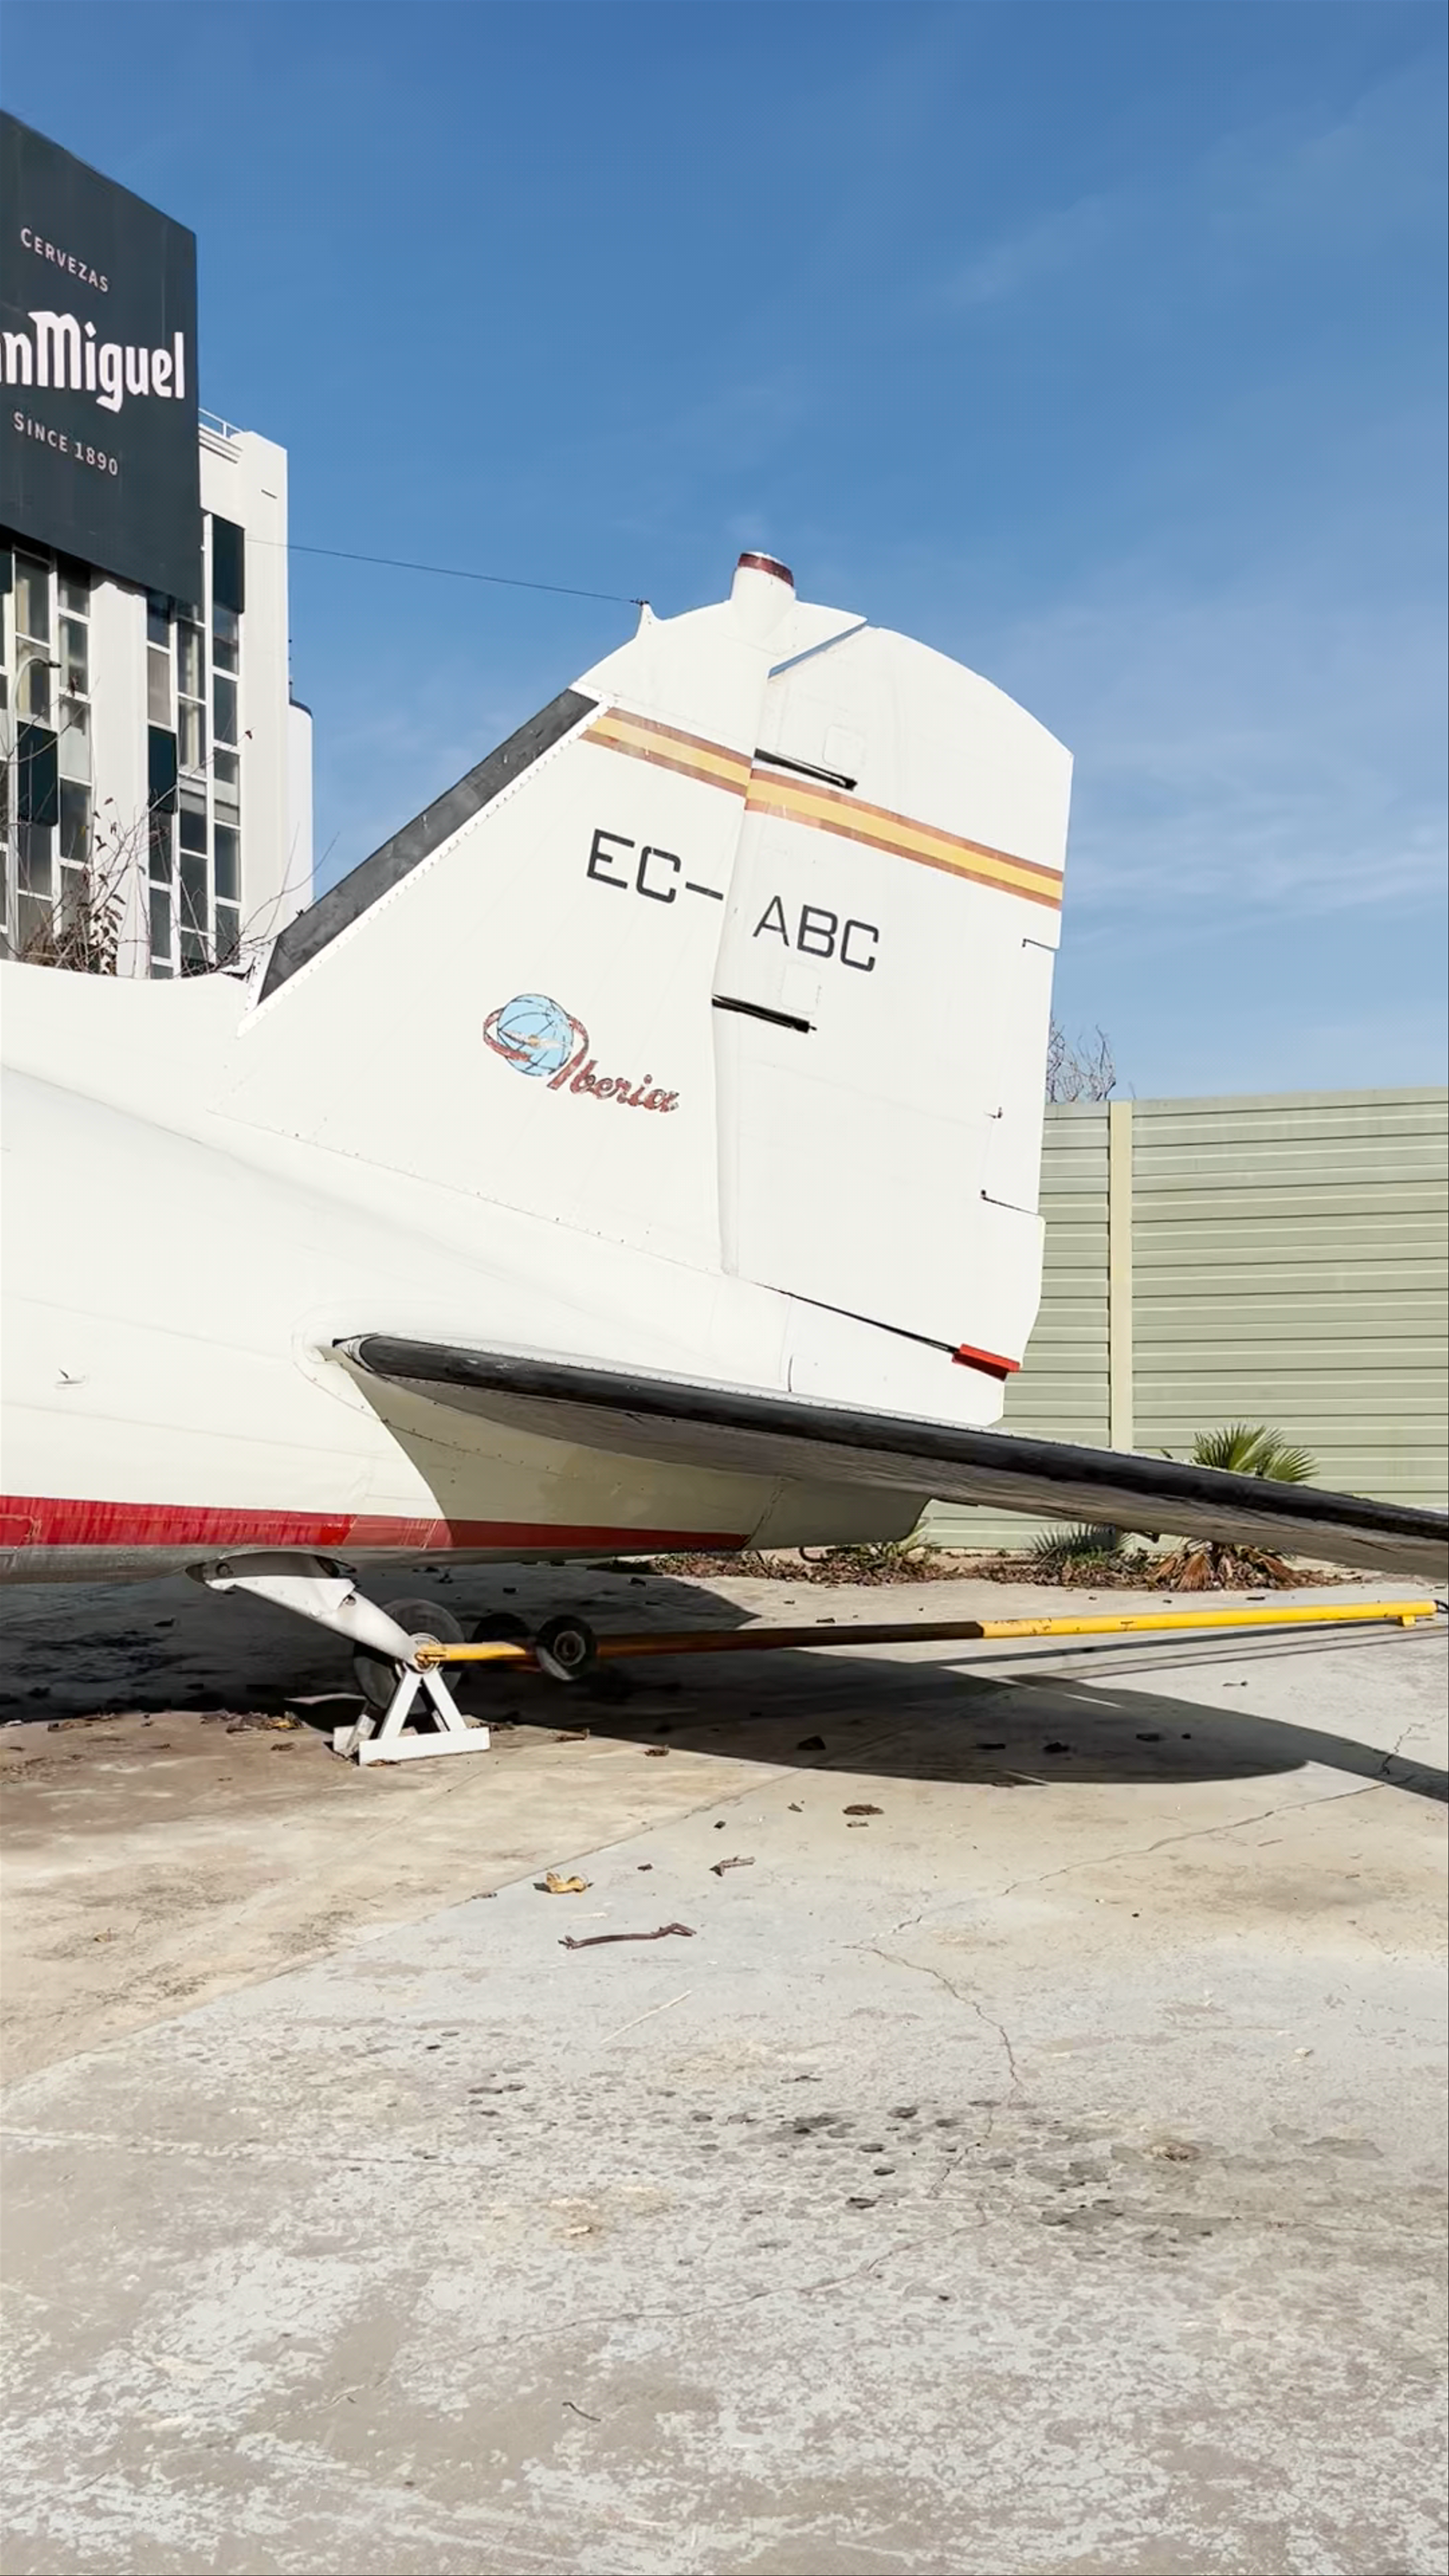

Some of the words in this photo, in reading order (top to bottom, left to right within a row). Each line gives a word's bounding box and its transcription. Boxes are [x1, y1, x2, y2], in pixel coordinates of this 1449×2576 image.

[20, 227, 109, 293] CERVEZAS
[14, 411, 68, 452] SINCE
[75, 442, 118, 476] 1890
[753, 896, 879, 972] ABC
[547, 1046, 679, 1112] Iberia
